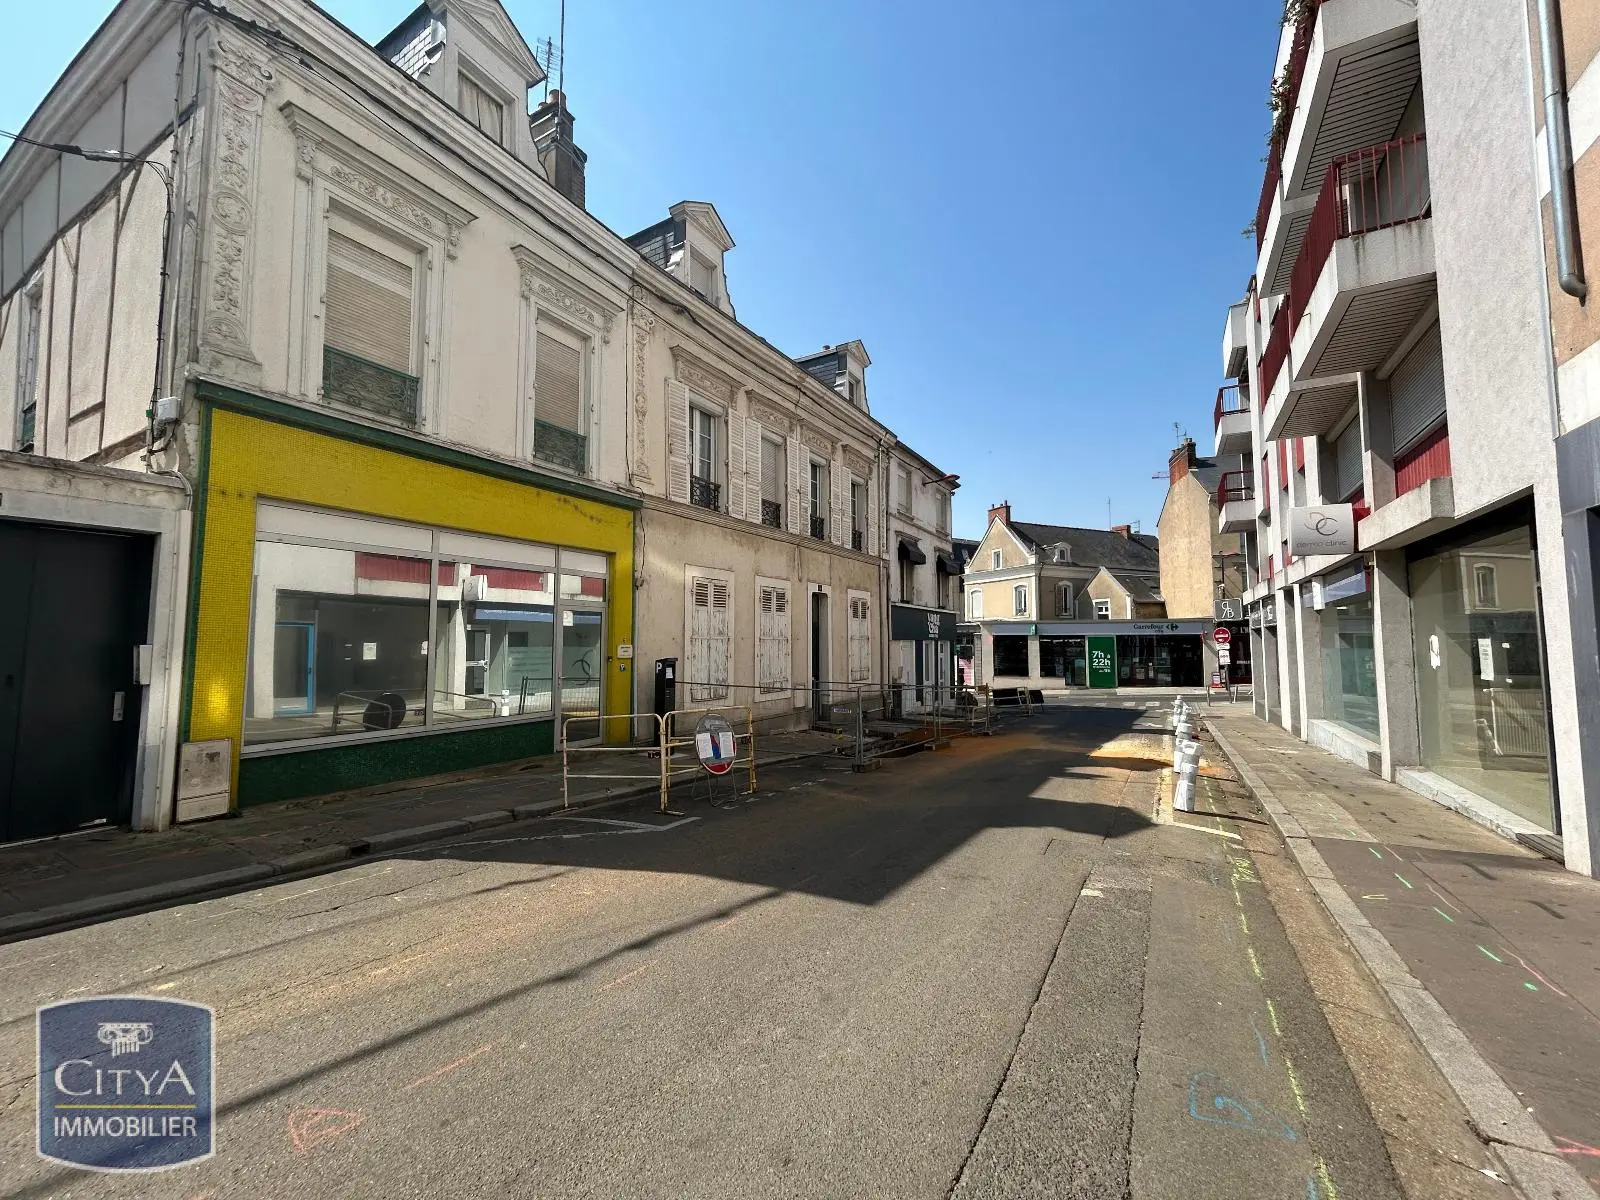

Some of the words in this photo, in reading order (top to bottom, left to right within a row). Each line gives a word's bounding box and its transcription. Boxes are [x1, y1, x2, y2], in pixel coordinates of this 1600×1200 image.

[1092, 650, 1104, 658] 7h
[1092, 658, 1111, 666] 22h
[656, 662, 663, 673] P
